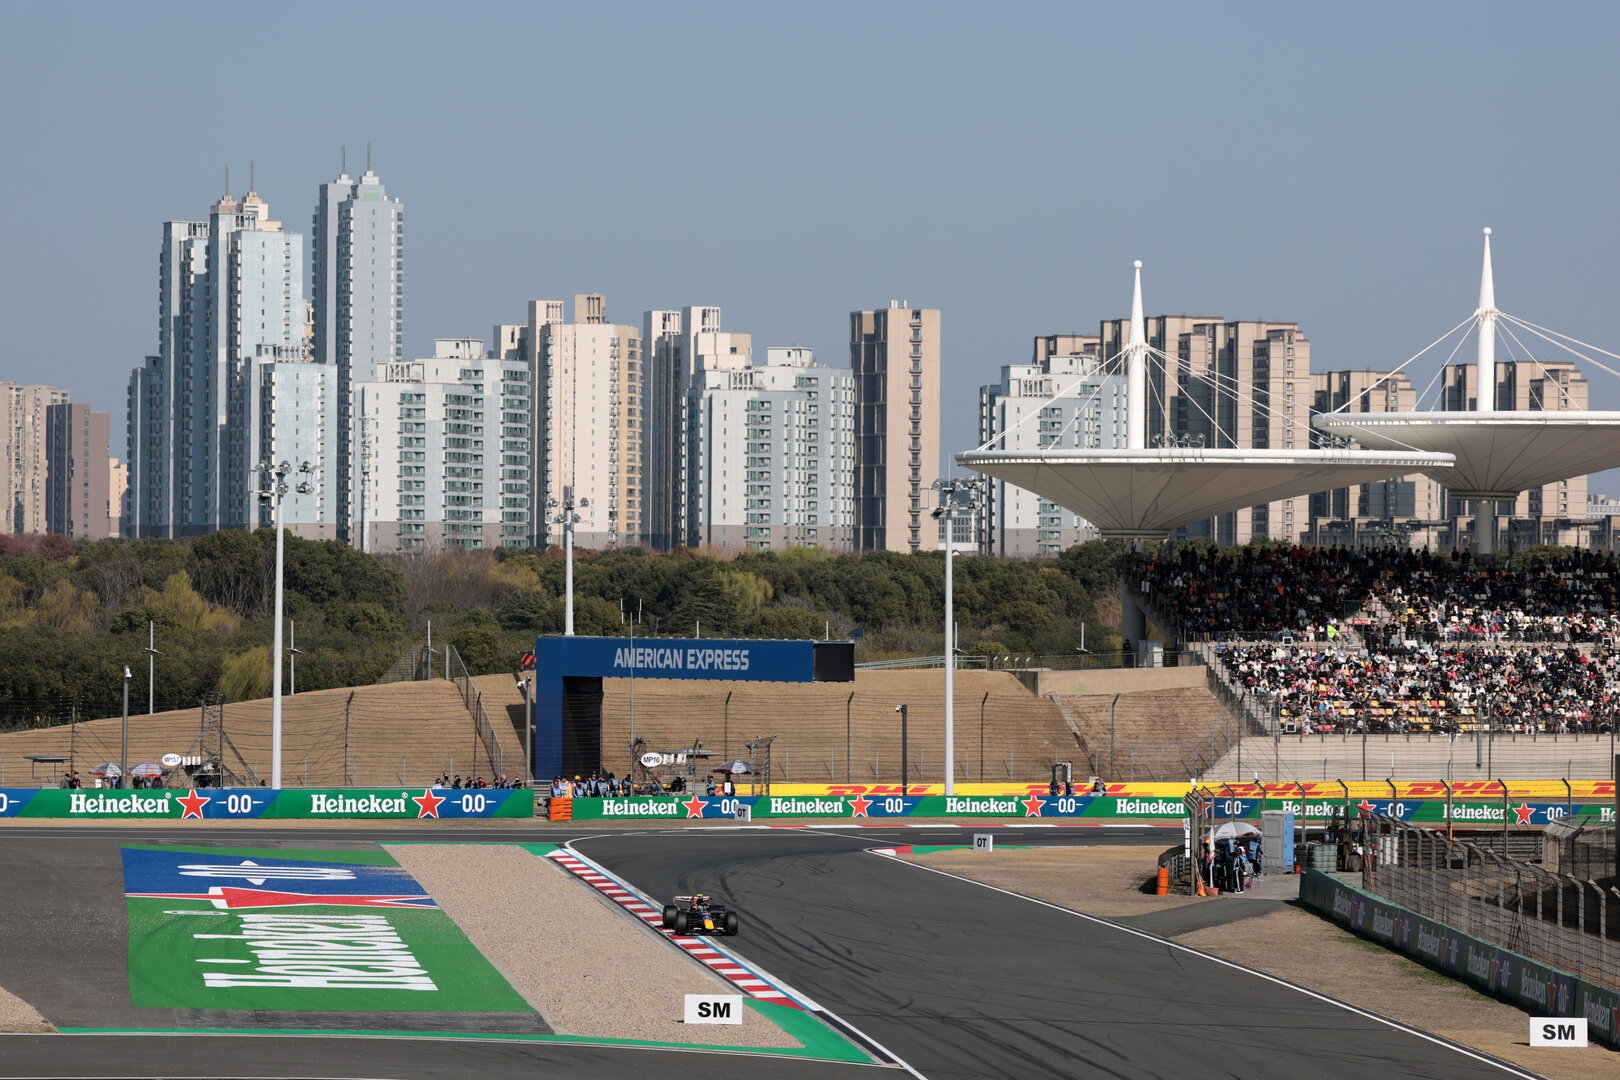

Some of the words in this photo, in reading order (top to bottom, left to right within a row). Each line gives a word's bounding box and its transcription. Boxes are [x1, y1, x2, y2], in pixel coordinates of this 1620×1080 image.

[613, 648, 683, 670] AMERICAN
[687, 649, 750, 671] EXPRESS
[643, 755, 661, 764] MP16
[1216, 783, 1320, 797] DHL
[1406, 782, 1508, 796] DHL
[69, 793, 171, 814] Heineken
[227, 794, 252, 814] 0.0
[310, 793, 407, 814] Heineken
[462, 793, 485, 813] 0.0
[602, 799, 678, 816] Heineken
[770, 797, 844, 815] Heineken
[885, 797, 904, 813] 0.0
[945, 798, 1018, 814] Heineken
[1058, 798, 1076, 813] 0.0
[1115, 798, 1186, 815] Heineken
[1224, 800, 1242, 815] 00
[1387, 802, 1405, 818] 00
[1546, 806, 1564, 821] 00
[193, 913, 439, 991] Heineken
[697, 1001, 731, 1018] SM
[1542, 1024, 1576, 1041] SM
